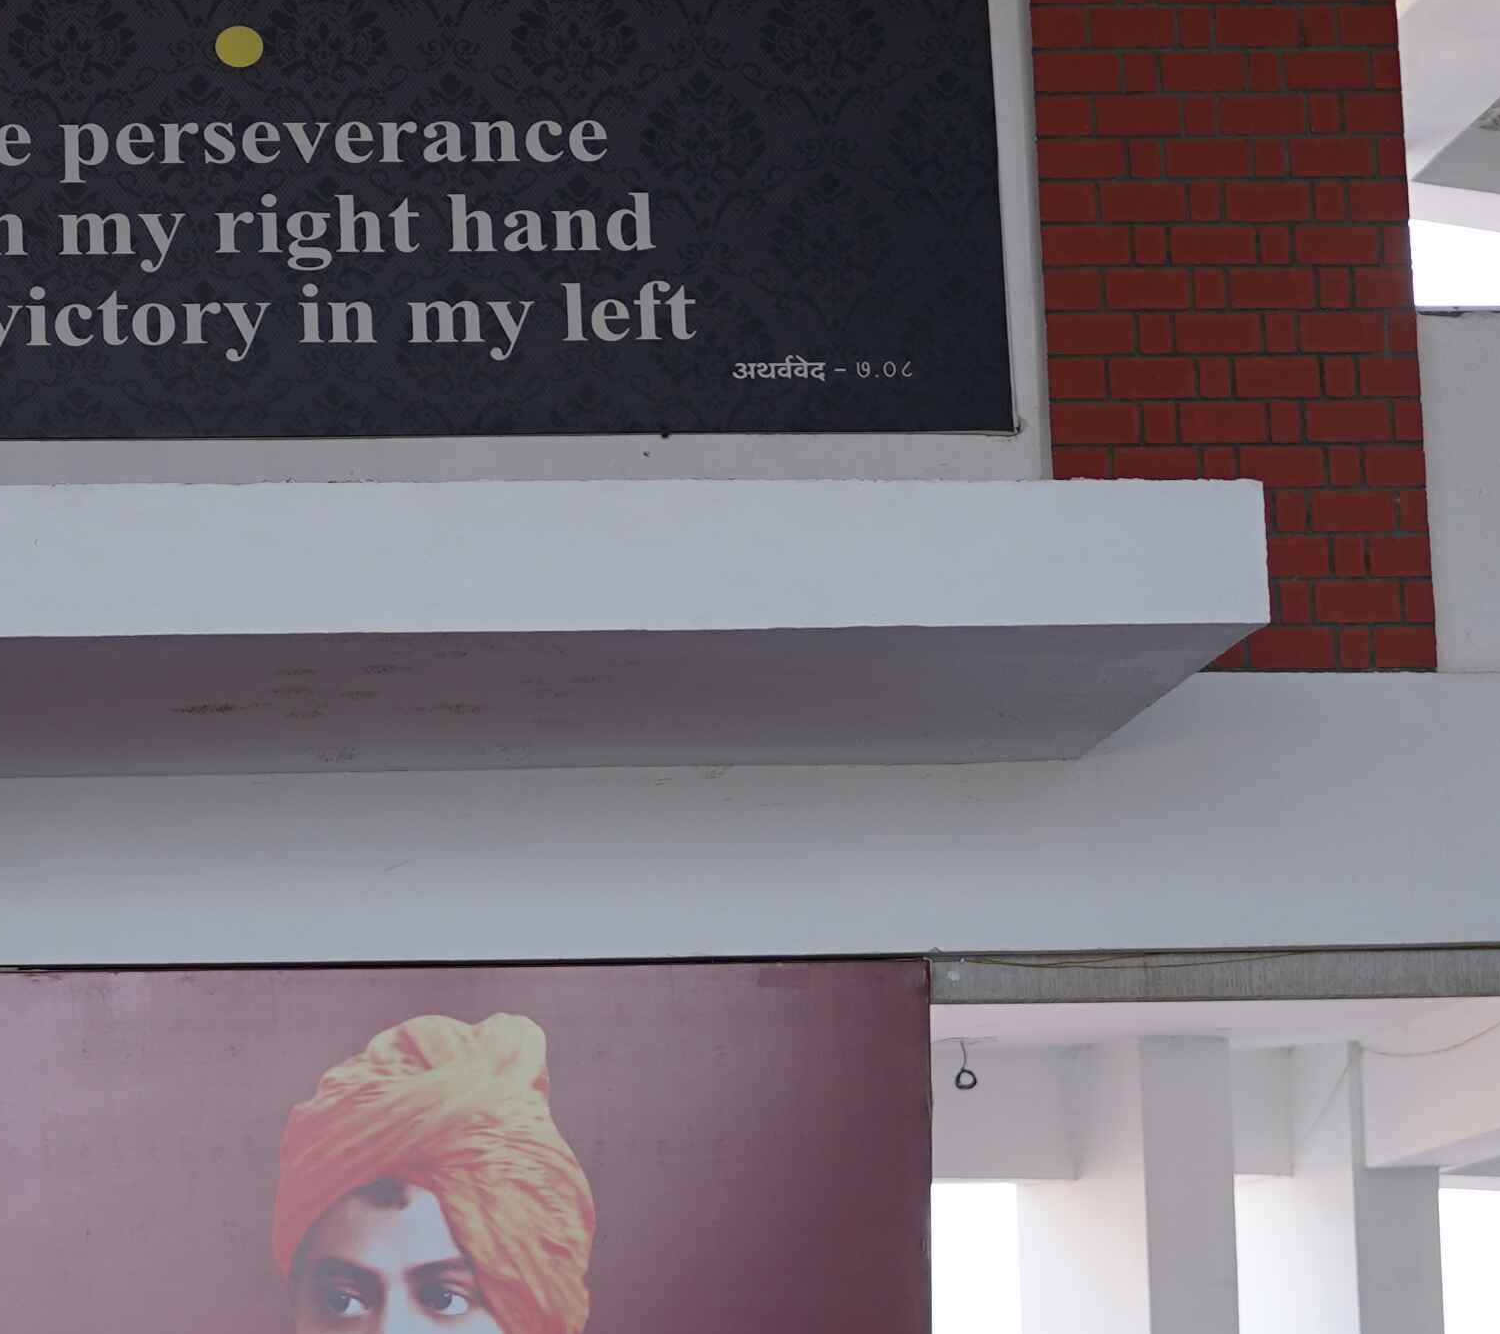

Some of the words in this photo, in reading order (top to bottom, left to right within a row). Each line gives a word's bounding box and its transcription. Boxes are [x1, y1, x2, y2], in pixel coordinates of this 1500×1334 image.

[58, 119, 608, 184] perseverance
[58, 212, 186, 273] my
[214, 193, 420, 271] right
[446, 192, 657, 252] hand
[298, 283, 378, 344] in
[407, 300, 535, 361] my
[560, 280, 697, 342] left
[731, 353, 827, 383] अथर्ववेद
